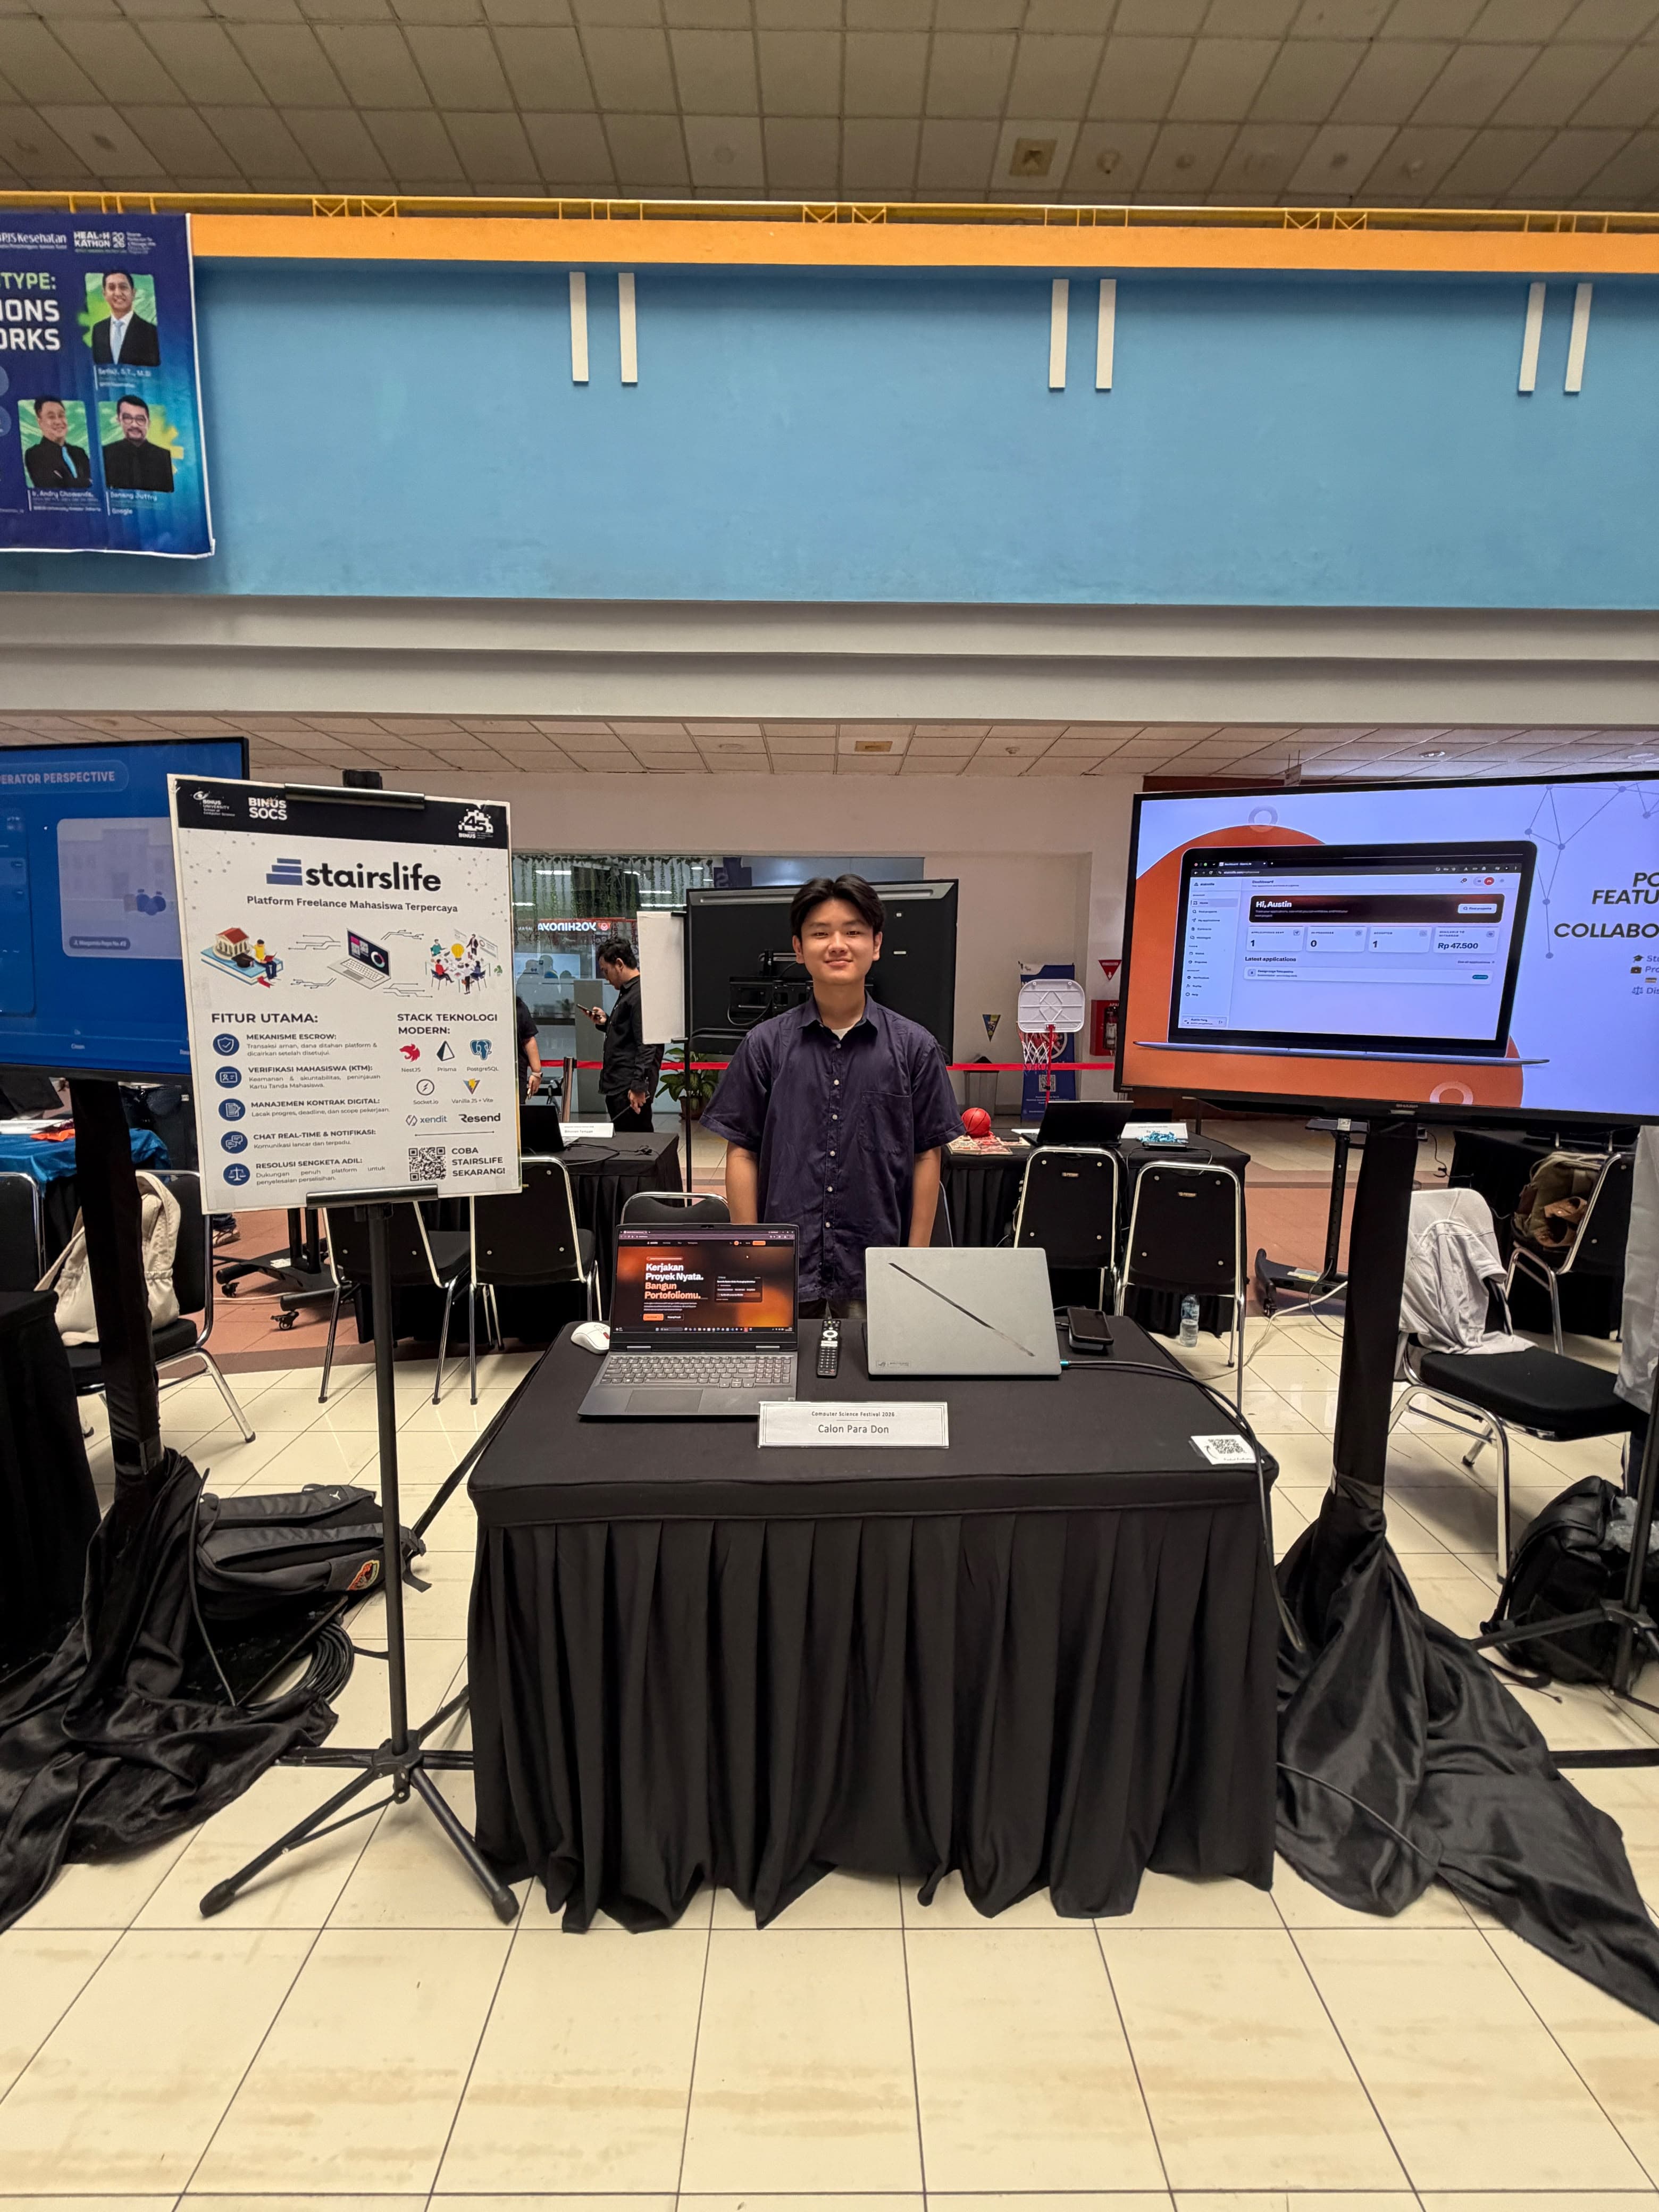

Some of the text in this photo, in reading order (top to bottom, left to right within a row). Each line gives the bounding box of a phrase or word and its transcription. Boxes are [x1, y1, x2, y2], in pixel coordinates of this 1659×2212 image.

[17, 232, 66, 244] Kesehatan
[44, 771, 115, 783] PERSPECTIVE
[248, 797, 287, 809] BINUS
[249, 807, 288, 820] SOCS
[464, 816, 487, 832] 45
[306, 861, 441, 892] stairslife
[1591, 890, 1659, 904] FEATU
[247, 895, 458, 914] Platform Freelance Mahasiswa Terpercaya
[1554, 923, 1659, 939] COLLABO
[212, 1013, 318, 1023] FITUR UTAMA:
[420, 1113, 501, 1124] xendit Resend
[452, 1157, 503, 1166] STAIRSLIFE
[452, 1167, 506, 1177] SEKARANG!
[646, 1263, 684, 1272] Kerjakan
[646, 1272, 704, 1282] Proyek Nyata.
[645, 1282, 677, 1291] Bangun
[644, 1291, 701, 1300] Portofoliomu.
[818, 1424, 889, 1434] Calon Para Don
